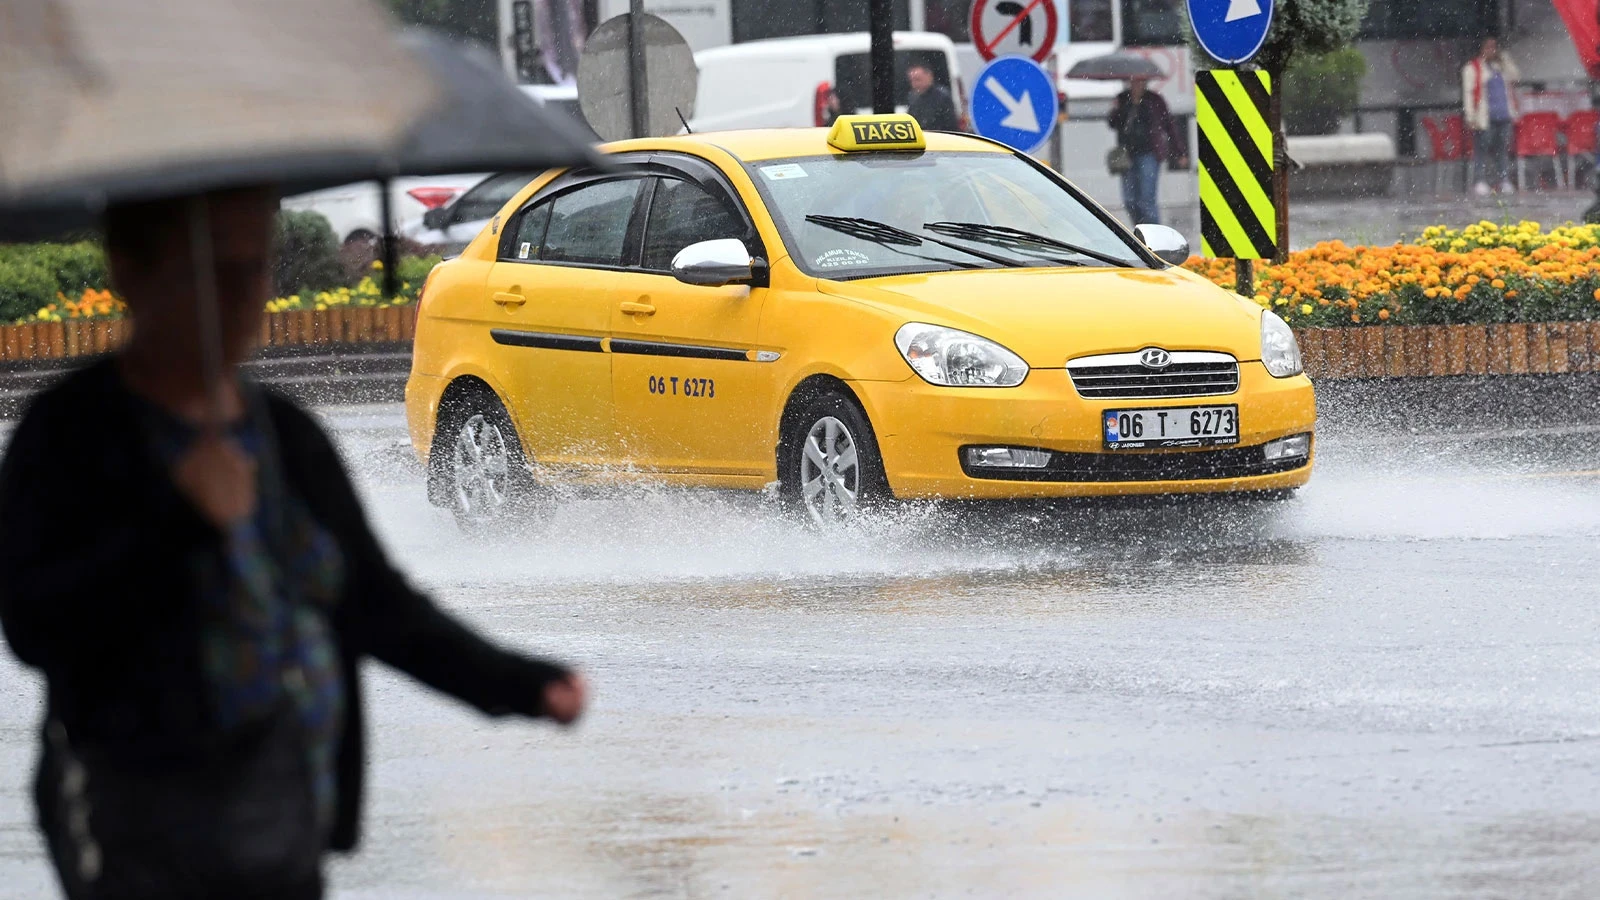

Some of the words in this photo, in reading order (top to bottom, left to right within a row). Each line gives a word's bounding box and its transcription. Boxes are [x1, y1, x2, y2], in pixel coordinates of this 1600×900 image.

[649, 375, 666, 395] 06
[670, 376, 679, 396] T
[684, 378, 715, 398] 6273
[1119, 413, 1143, 438] 06
[1157, 412, 1168, 437] T
[1190, 409, 1234, 436] 6273
